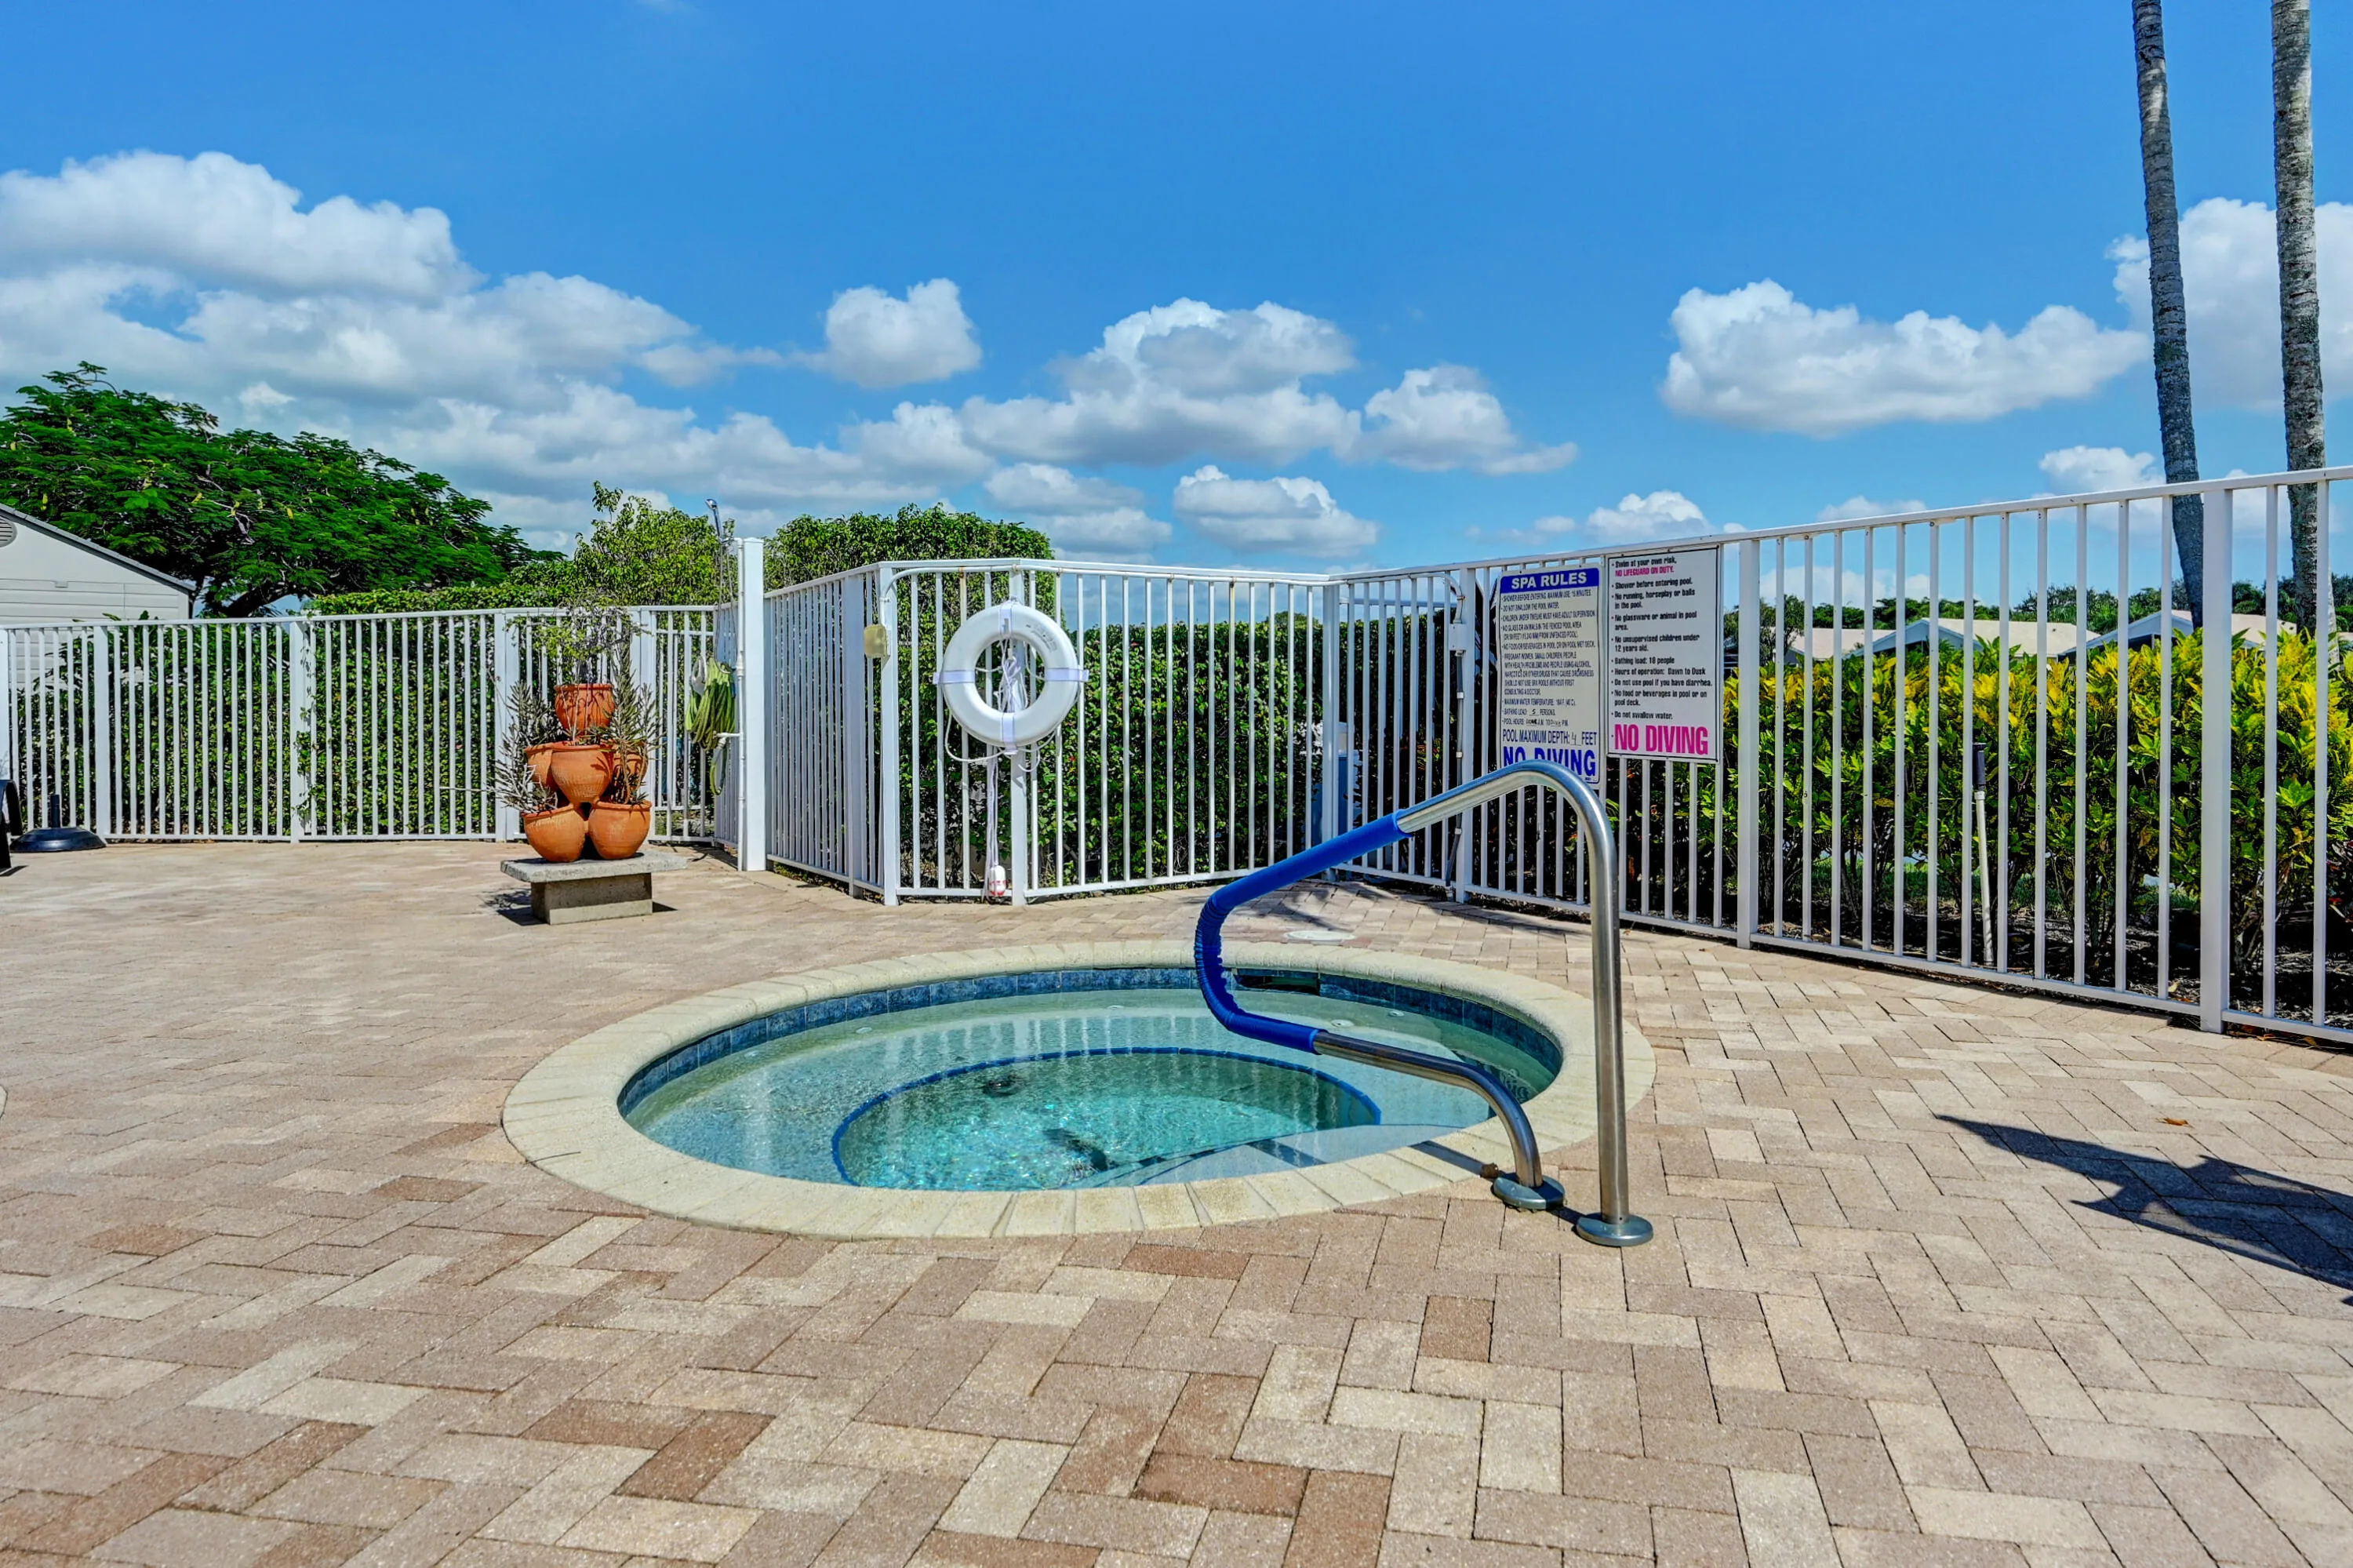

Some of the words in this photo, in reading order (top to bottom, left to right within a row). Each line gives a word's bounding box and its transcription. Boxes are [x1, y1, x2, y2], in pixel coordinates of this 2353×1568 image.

[1511, 577, 1537, 590] SPA
[1540, 572, 1587, 588] RULES
[1655, 578, 1678, 587] entering
[1646, 590, 1672, 598] horseplay
[1685, 611, 1697, 620] pool
[1503, 729, 1518, 742] POOL
[1518, 729, 1547, 744] MAXIMUM
[1548, 731, 1570, 744] DEPTH:
[1581, 732, 1597, 745] FEET
[1614, 724, 1639, 751] NO
[1646, 725, 1708, 755] DIVING
[1503, 746, 1526, 766] NO
